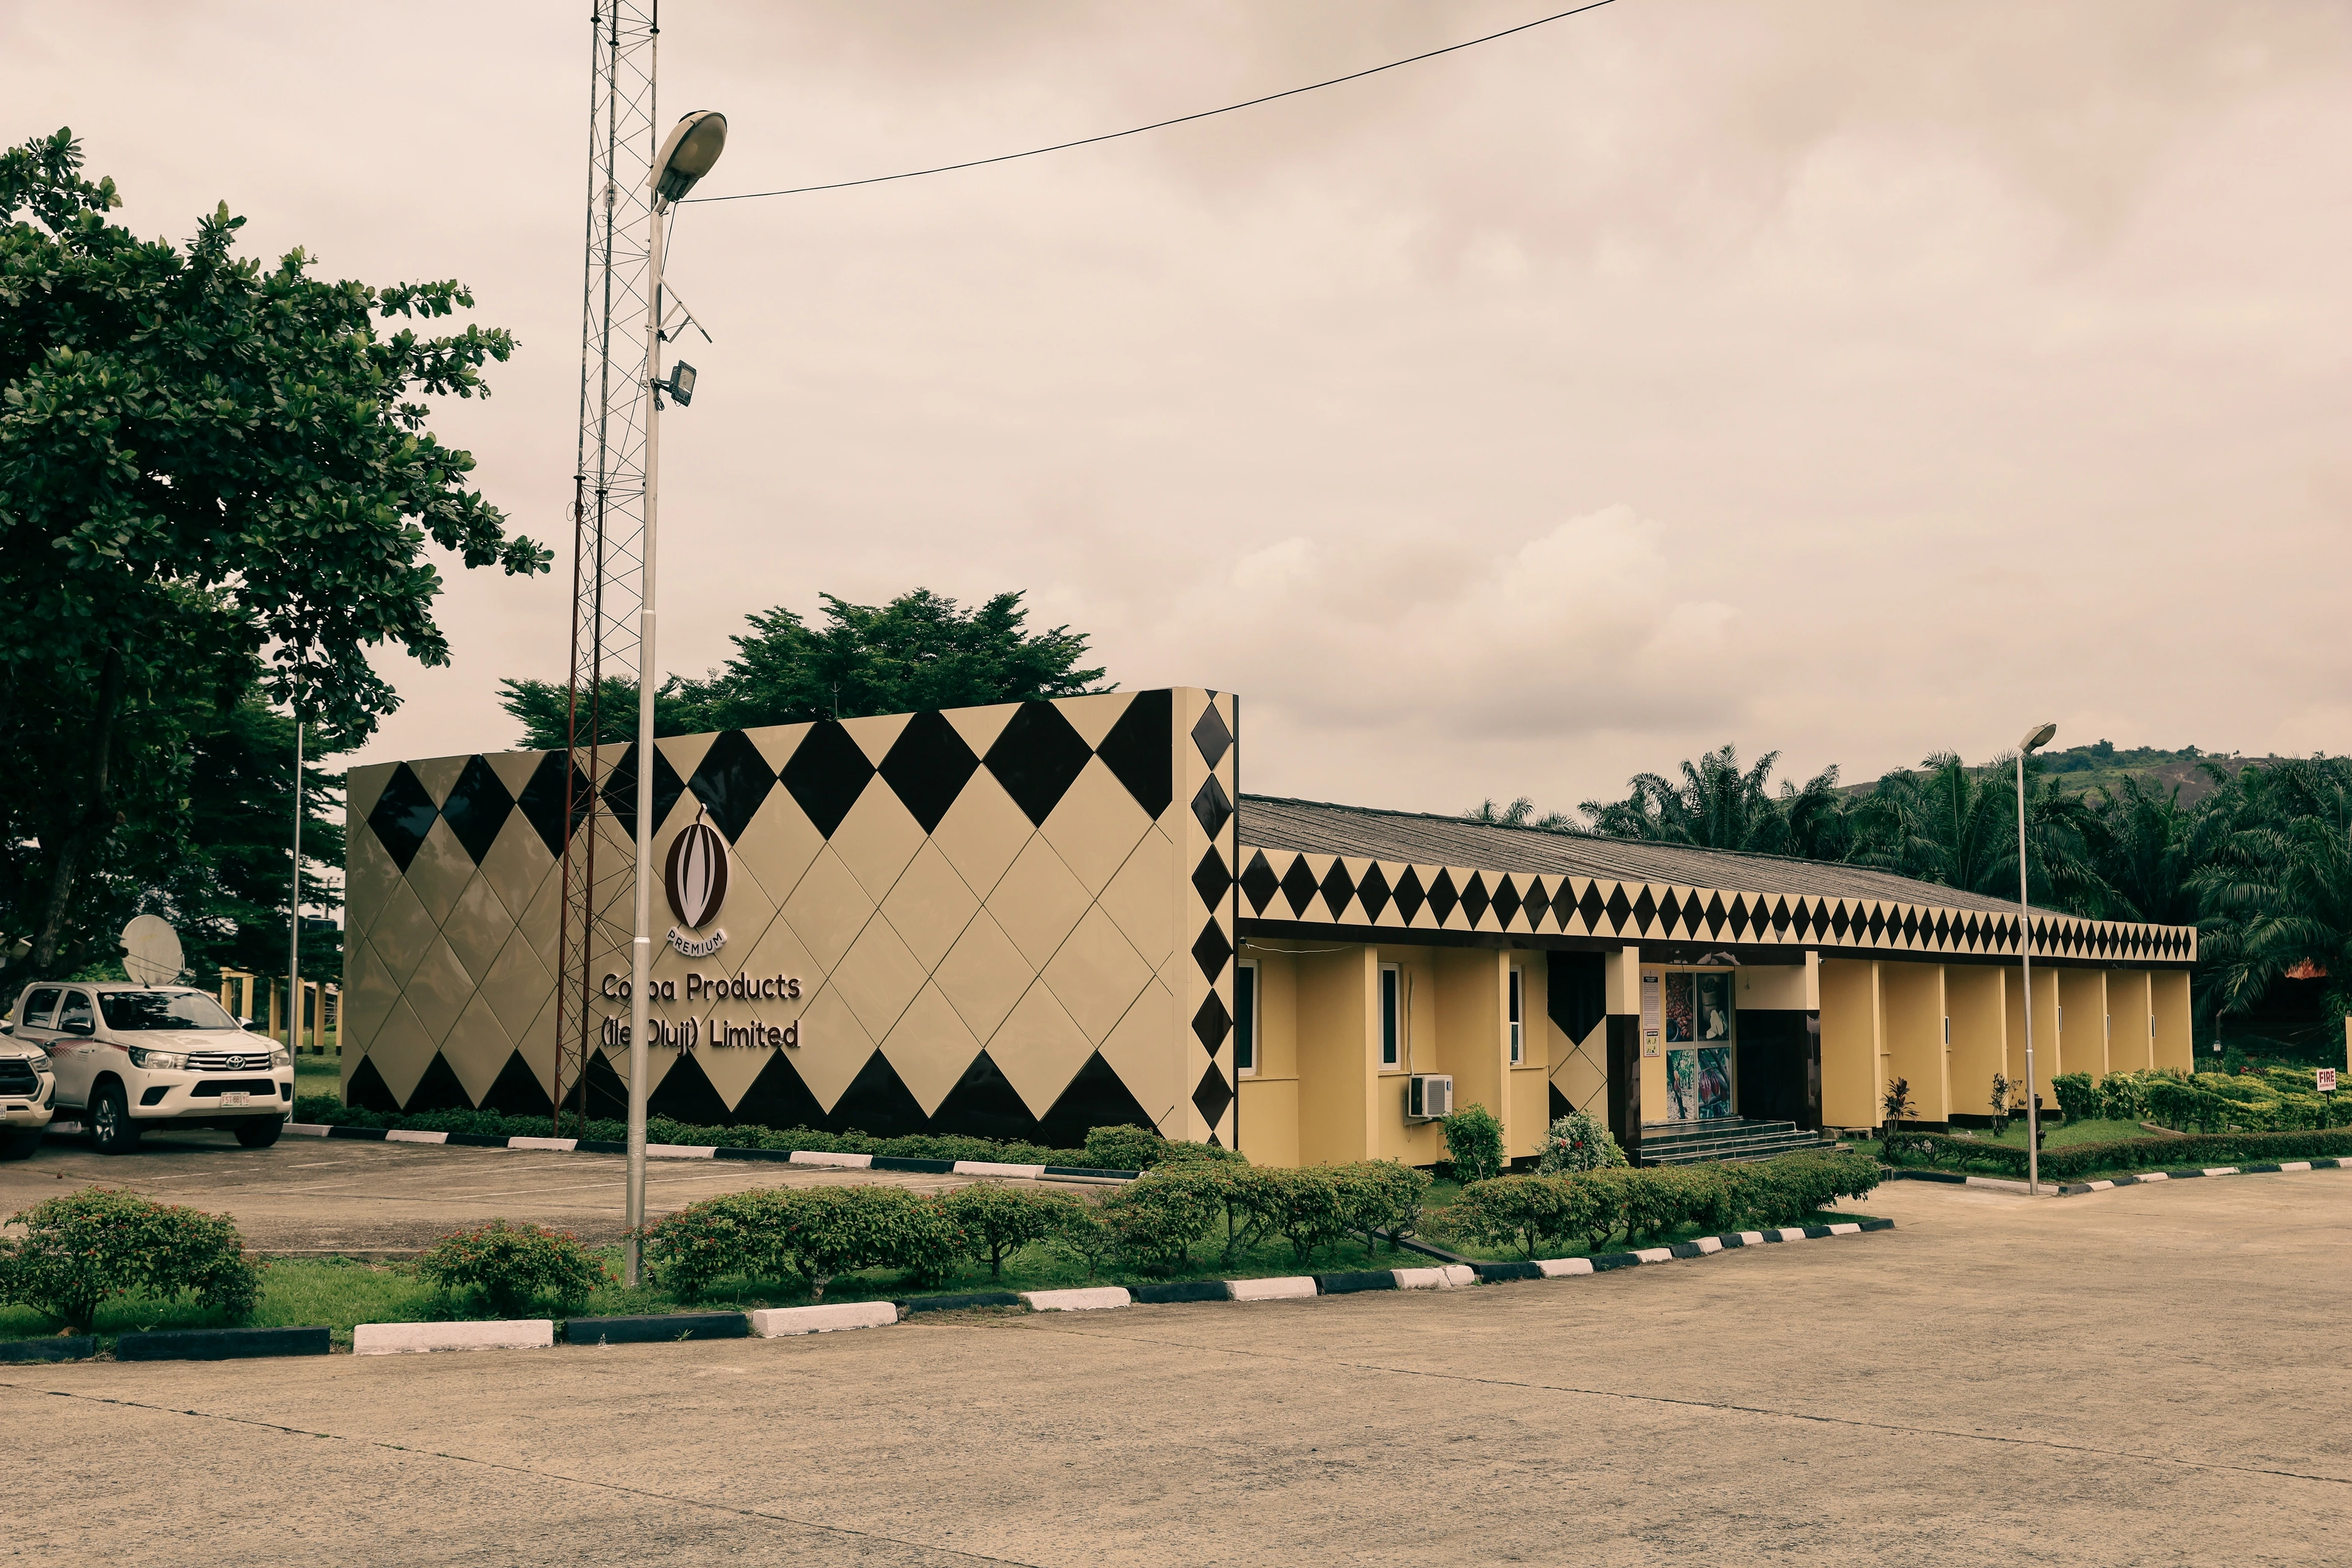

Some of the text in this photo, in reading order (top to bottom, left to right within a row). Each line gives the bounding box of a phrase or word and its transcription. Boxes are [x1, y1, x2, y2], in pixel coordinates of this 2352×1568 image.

[668, 930, 722, 954] PREMIUM
[602, 972, 801, 1000] Cooa Products
[710, 1019, 798, 1047] Limited
[2319, 1071, 2334, 1083] FIRE
